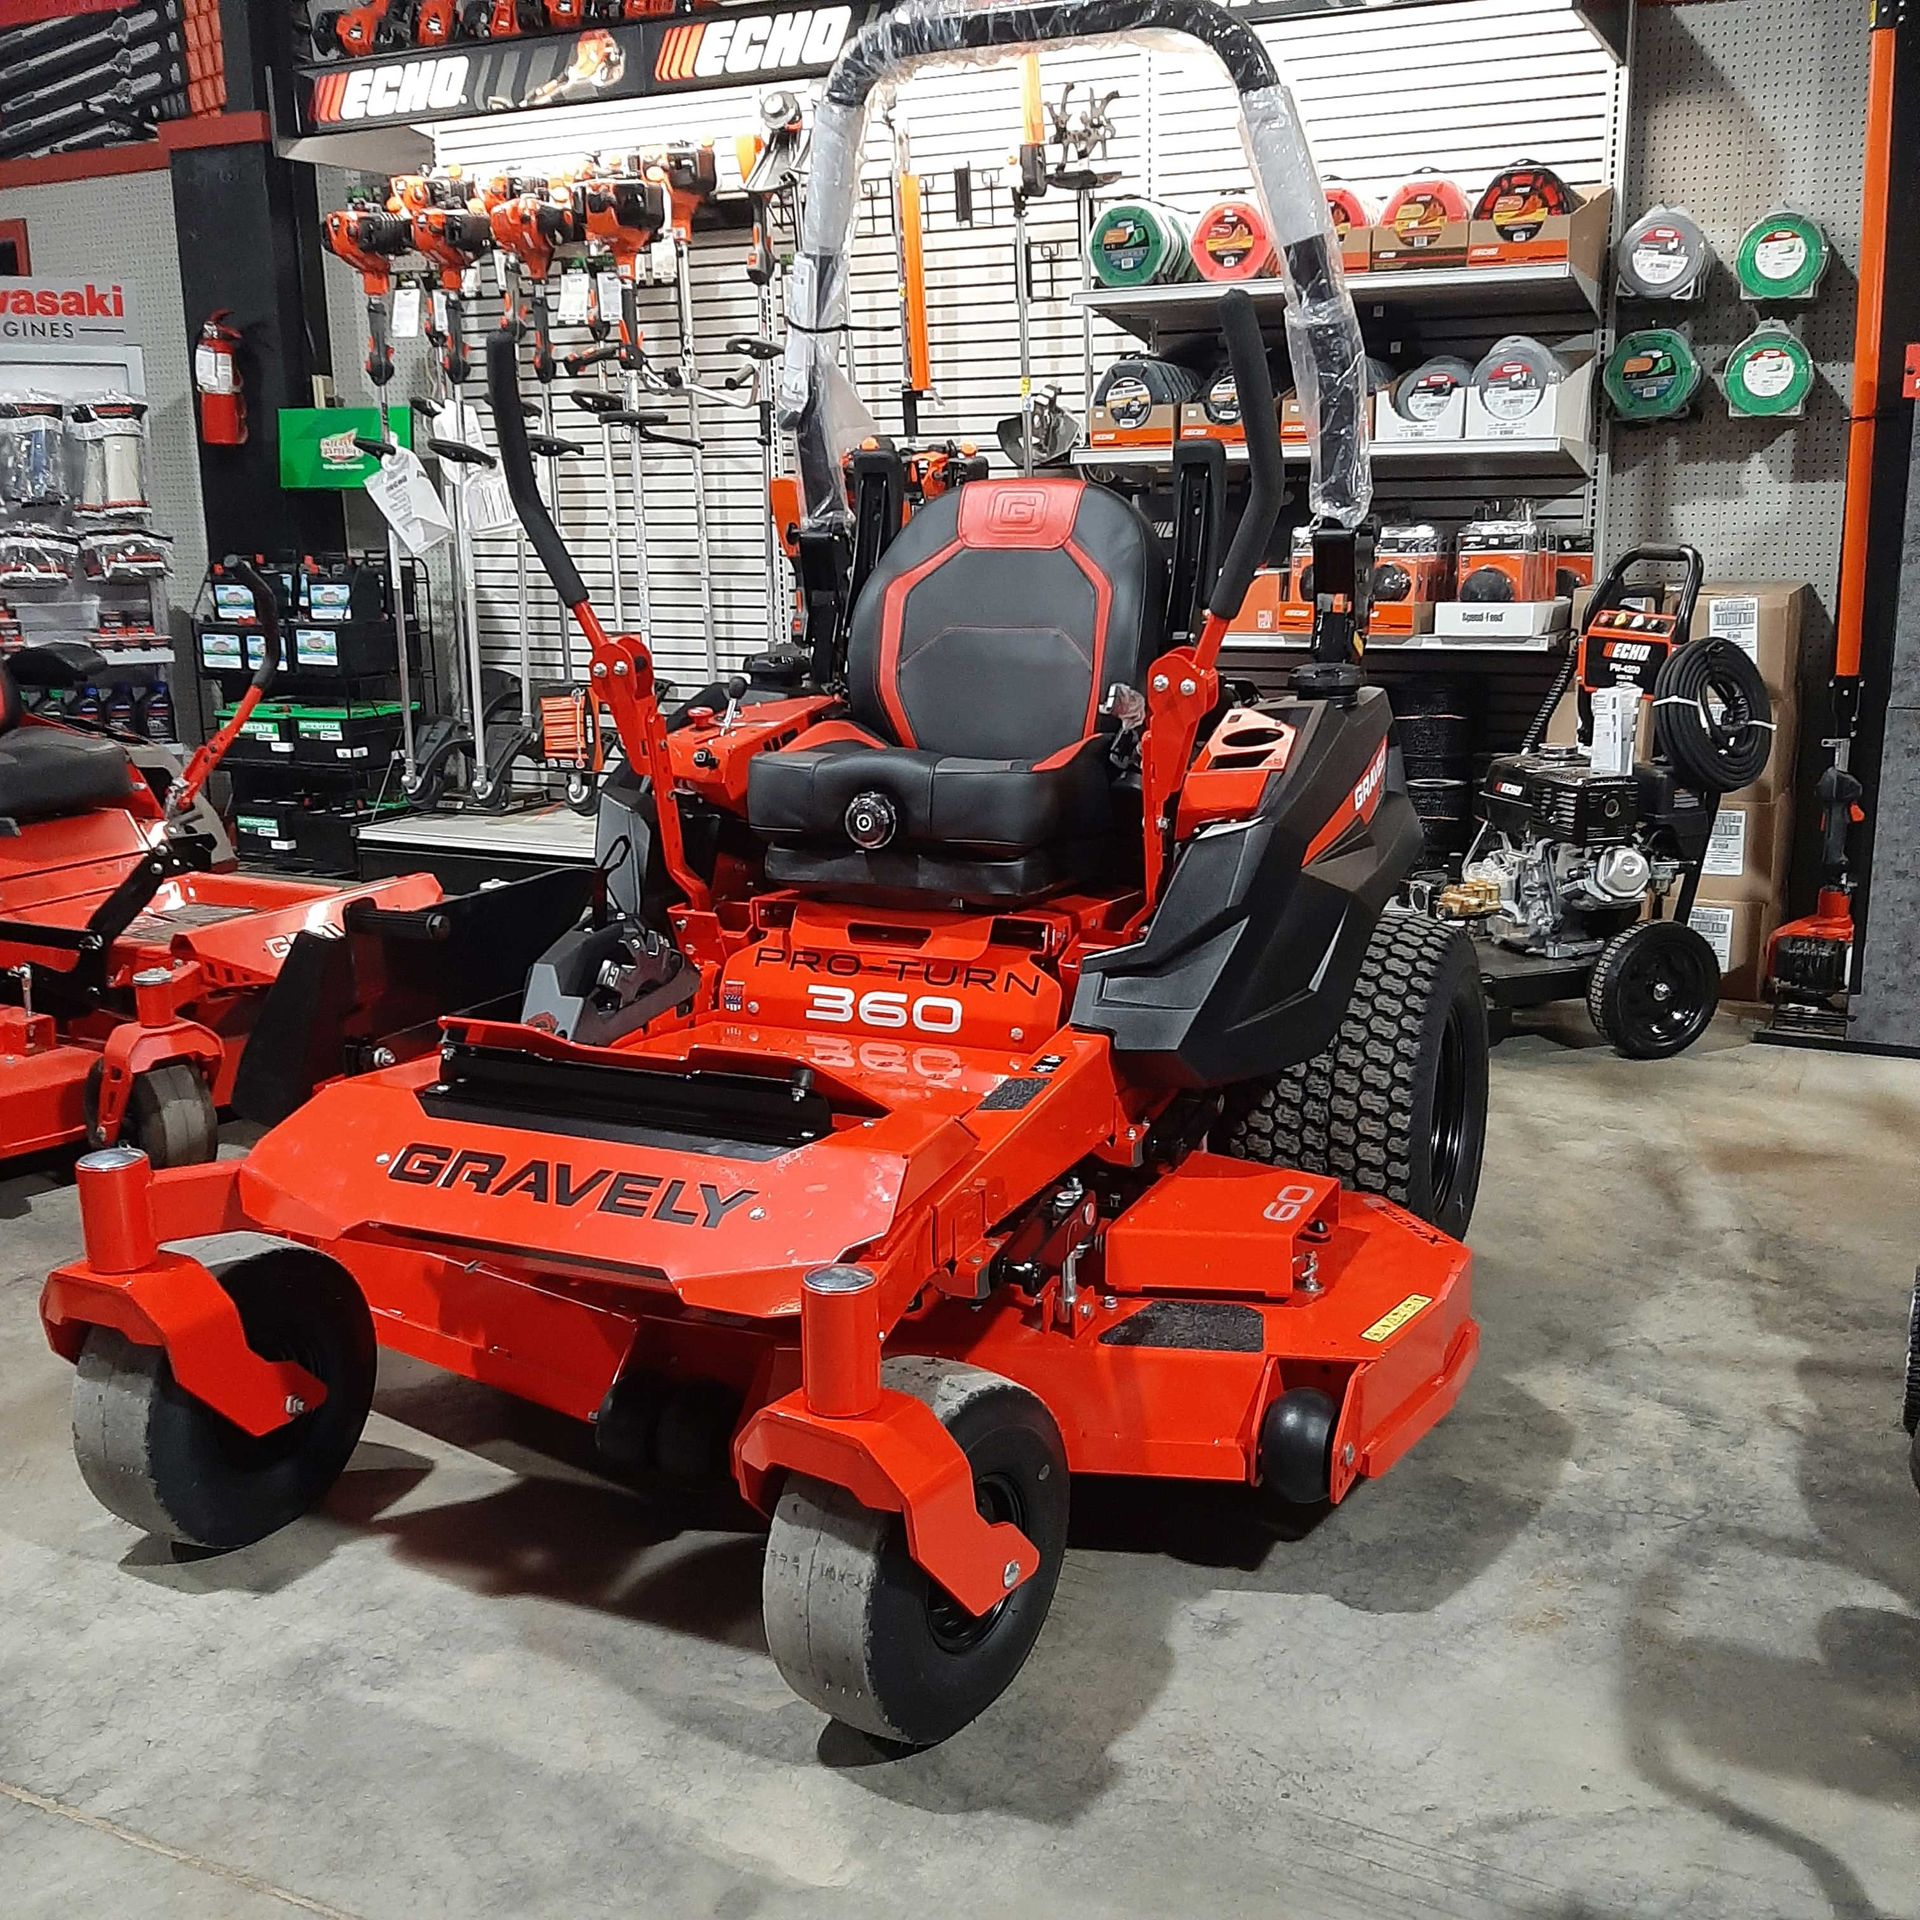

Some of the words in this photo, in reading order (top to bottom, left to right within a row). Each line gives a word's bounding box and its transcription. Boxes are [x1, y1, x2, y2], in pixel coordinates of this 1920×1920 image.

[694, 5, 852, 77] ECHO
[1611, 642, 1651, 661] ECHO
[755, 947, 1041, 997] PRO-TURN
[805, 984, 963, 1034] 360
[387, 1142, 760, 1230] GRAVELY
[1263, 1185, 1315, 1222] 60
